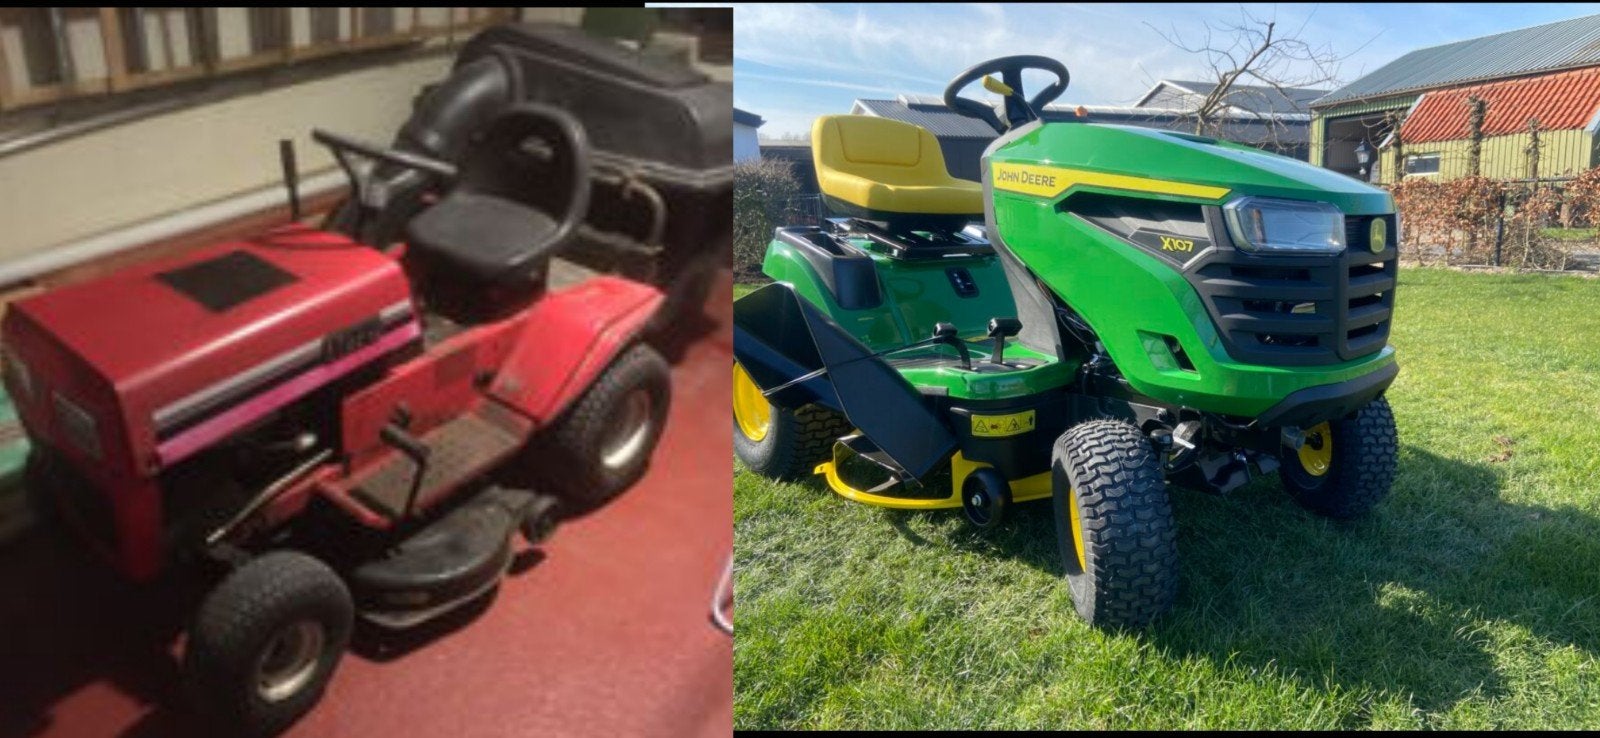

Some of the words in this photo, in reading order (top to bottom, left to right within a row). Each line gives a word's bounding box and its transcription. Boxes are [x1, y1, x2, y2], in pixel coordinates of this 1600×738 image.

[997, 168, 1019, 183] JOHN
[1021, 171, 1056, 187] DEERE
[1160, 235, 1193, 252] X107
